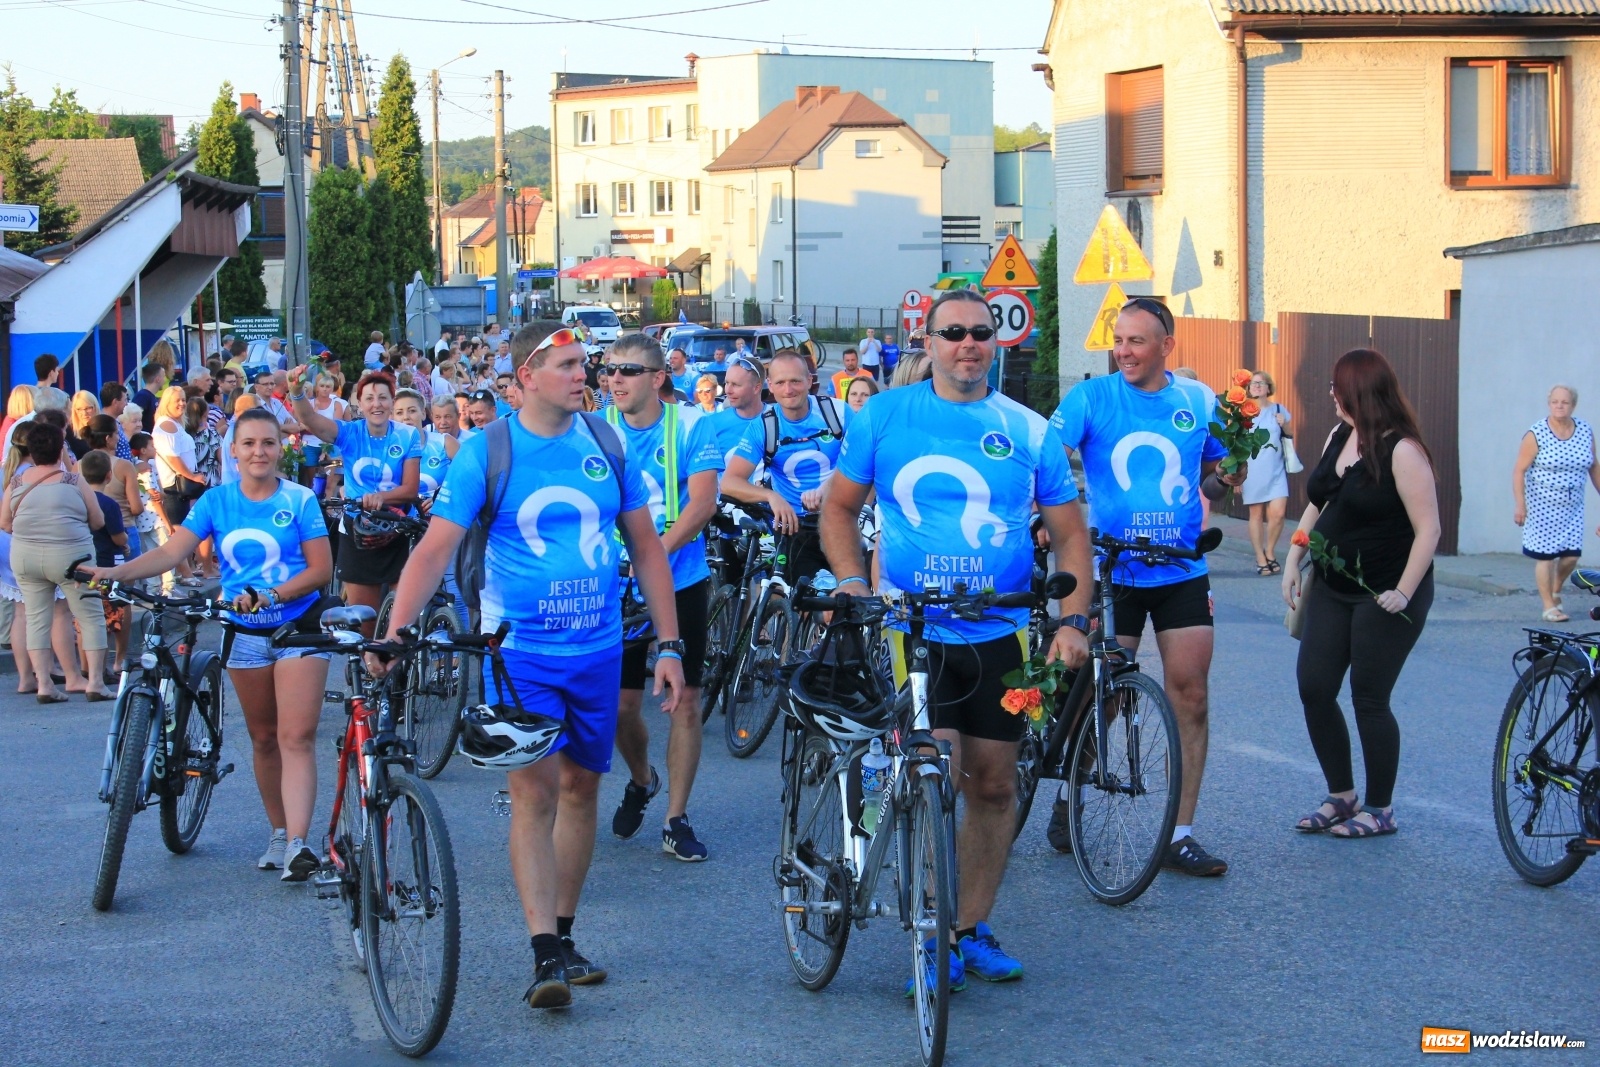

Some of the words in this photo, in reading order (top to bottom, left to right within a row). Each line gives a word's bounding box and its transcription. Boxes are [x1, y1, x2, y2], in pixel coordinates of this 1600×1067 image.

[990, 303, 1026, 331] 30
[1131, 511, 1175, 526] JESTEM
[923, 553, 983, 573] JESTEM
[548, 576, 599, 597] JESTEM
[538, 593, 605, 615] PAMIĘTAM
[241, 611, 283, 624] CZUWAM
[544, 612, 601, 631] CZUWAM
